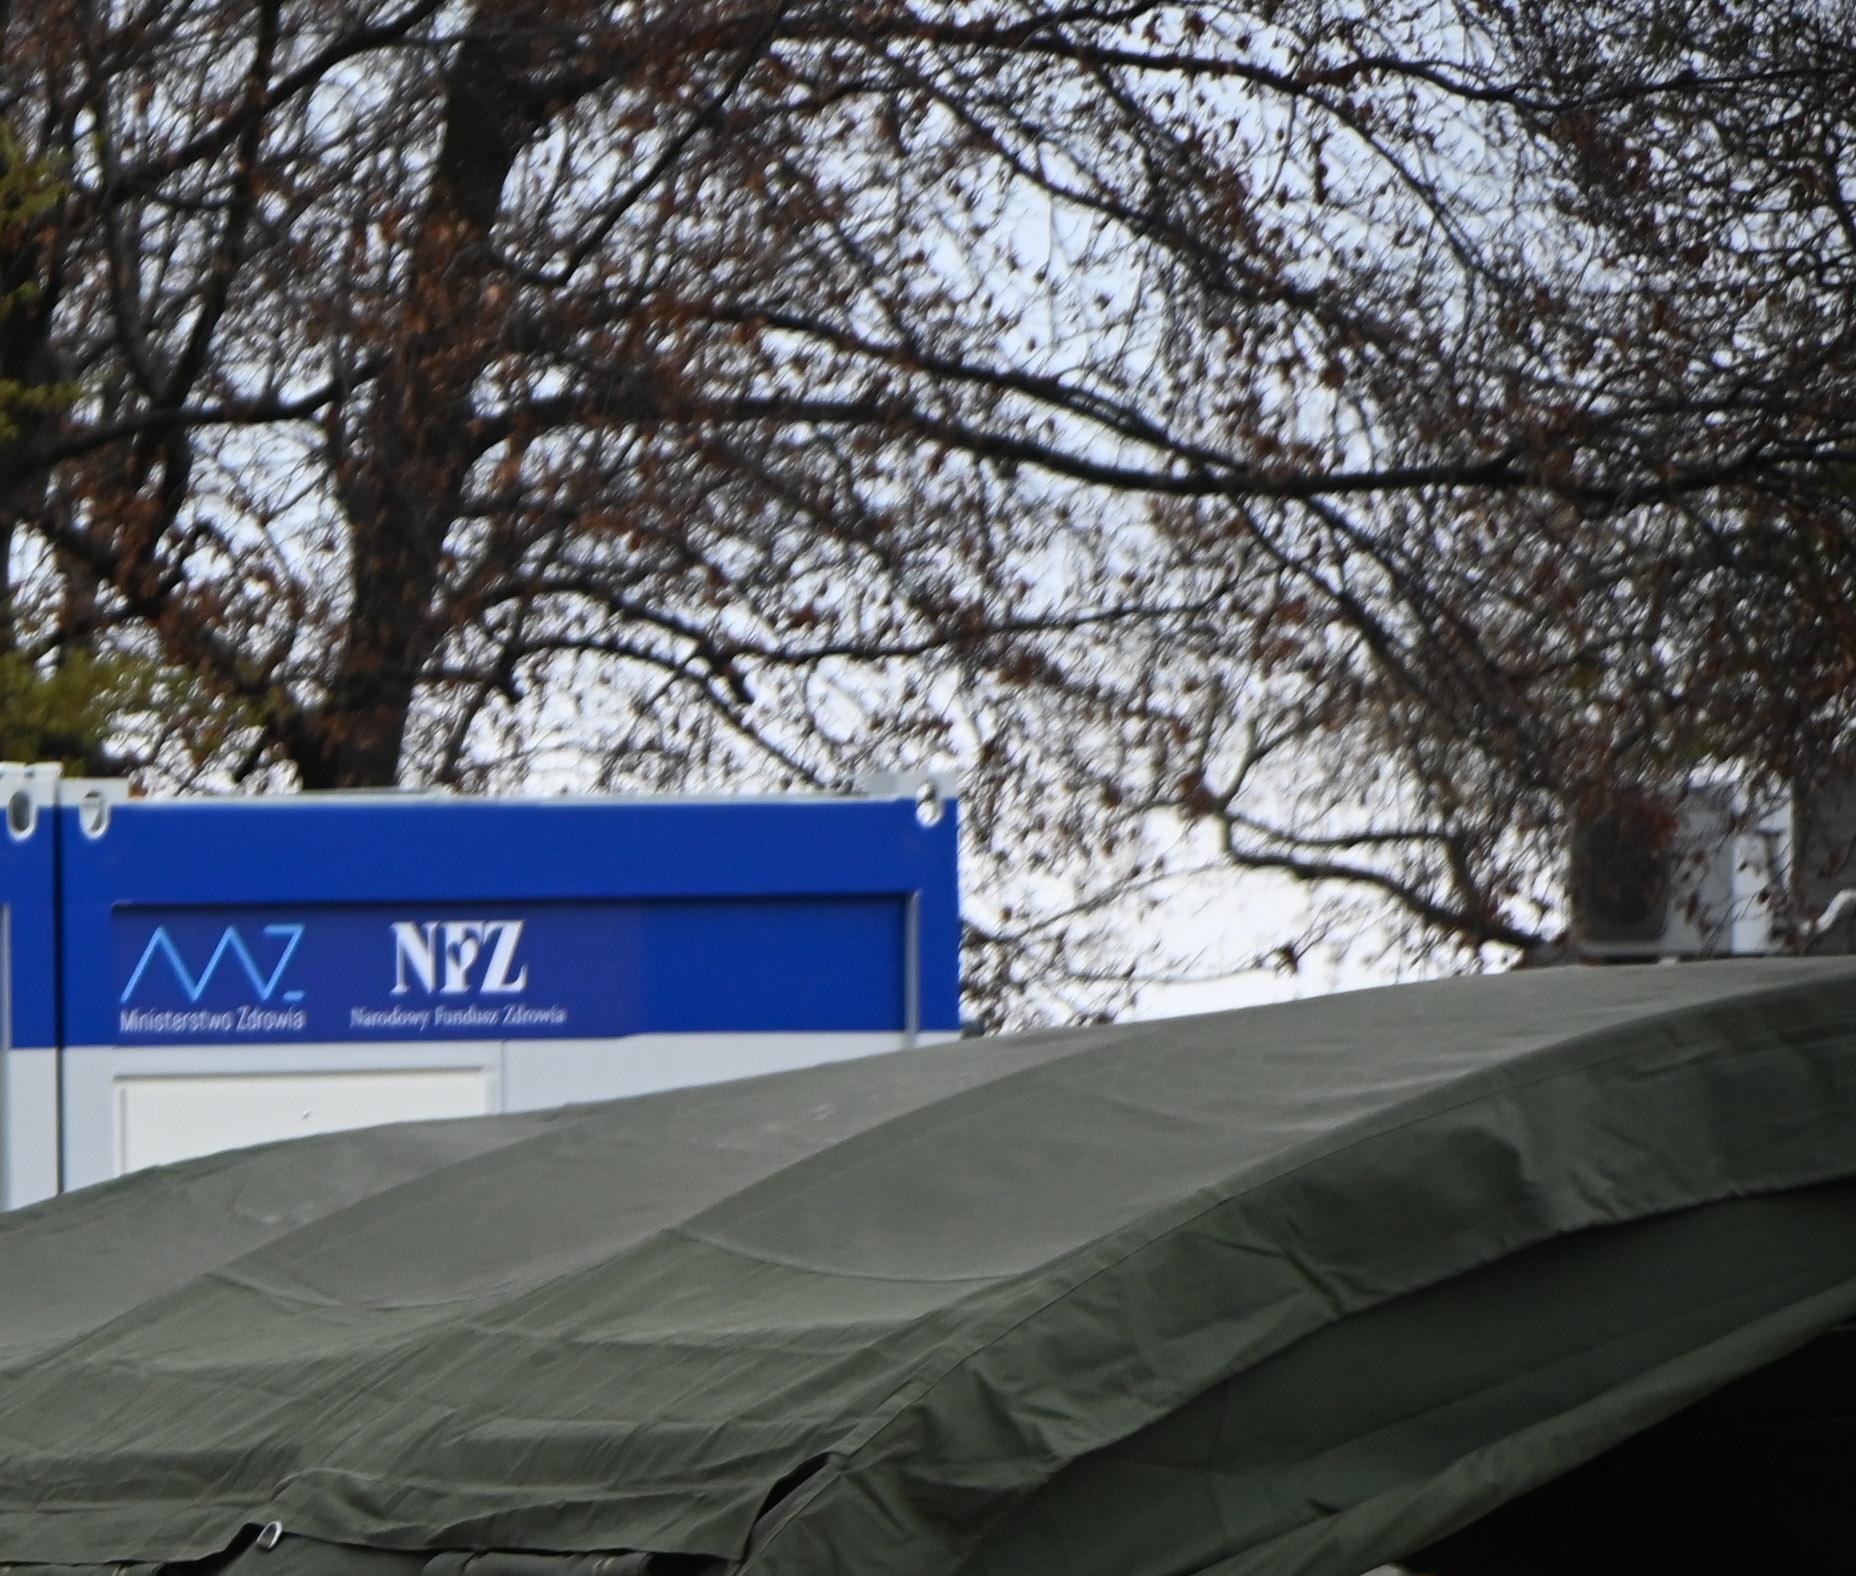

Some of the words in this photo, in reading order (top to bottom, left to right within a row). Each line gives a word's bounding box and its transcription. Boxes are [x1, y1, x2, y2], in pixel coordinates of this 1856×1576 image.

[390, 919, 528, 996] NFZ
[119, 1008, 234, 1034] Ministerstwo
[235, 1005, 306, 1031] Zdrowia
[350, 1007, 432, 1031] Narodowy
[435, 1005, 499, 1027] Fundusz
[502, 1004, 568, 1026] Zdrowia
